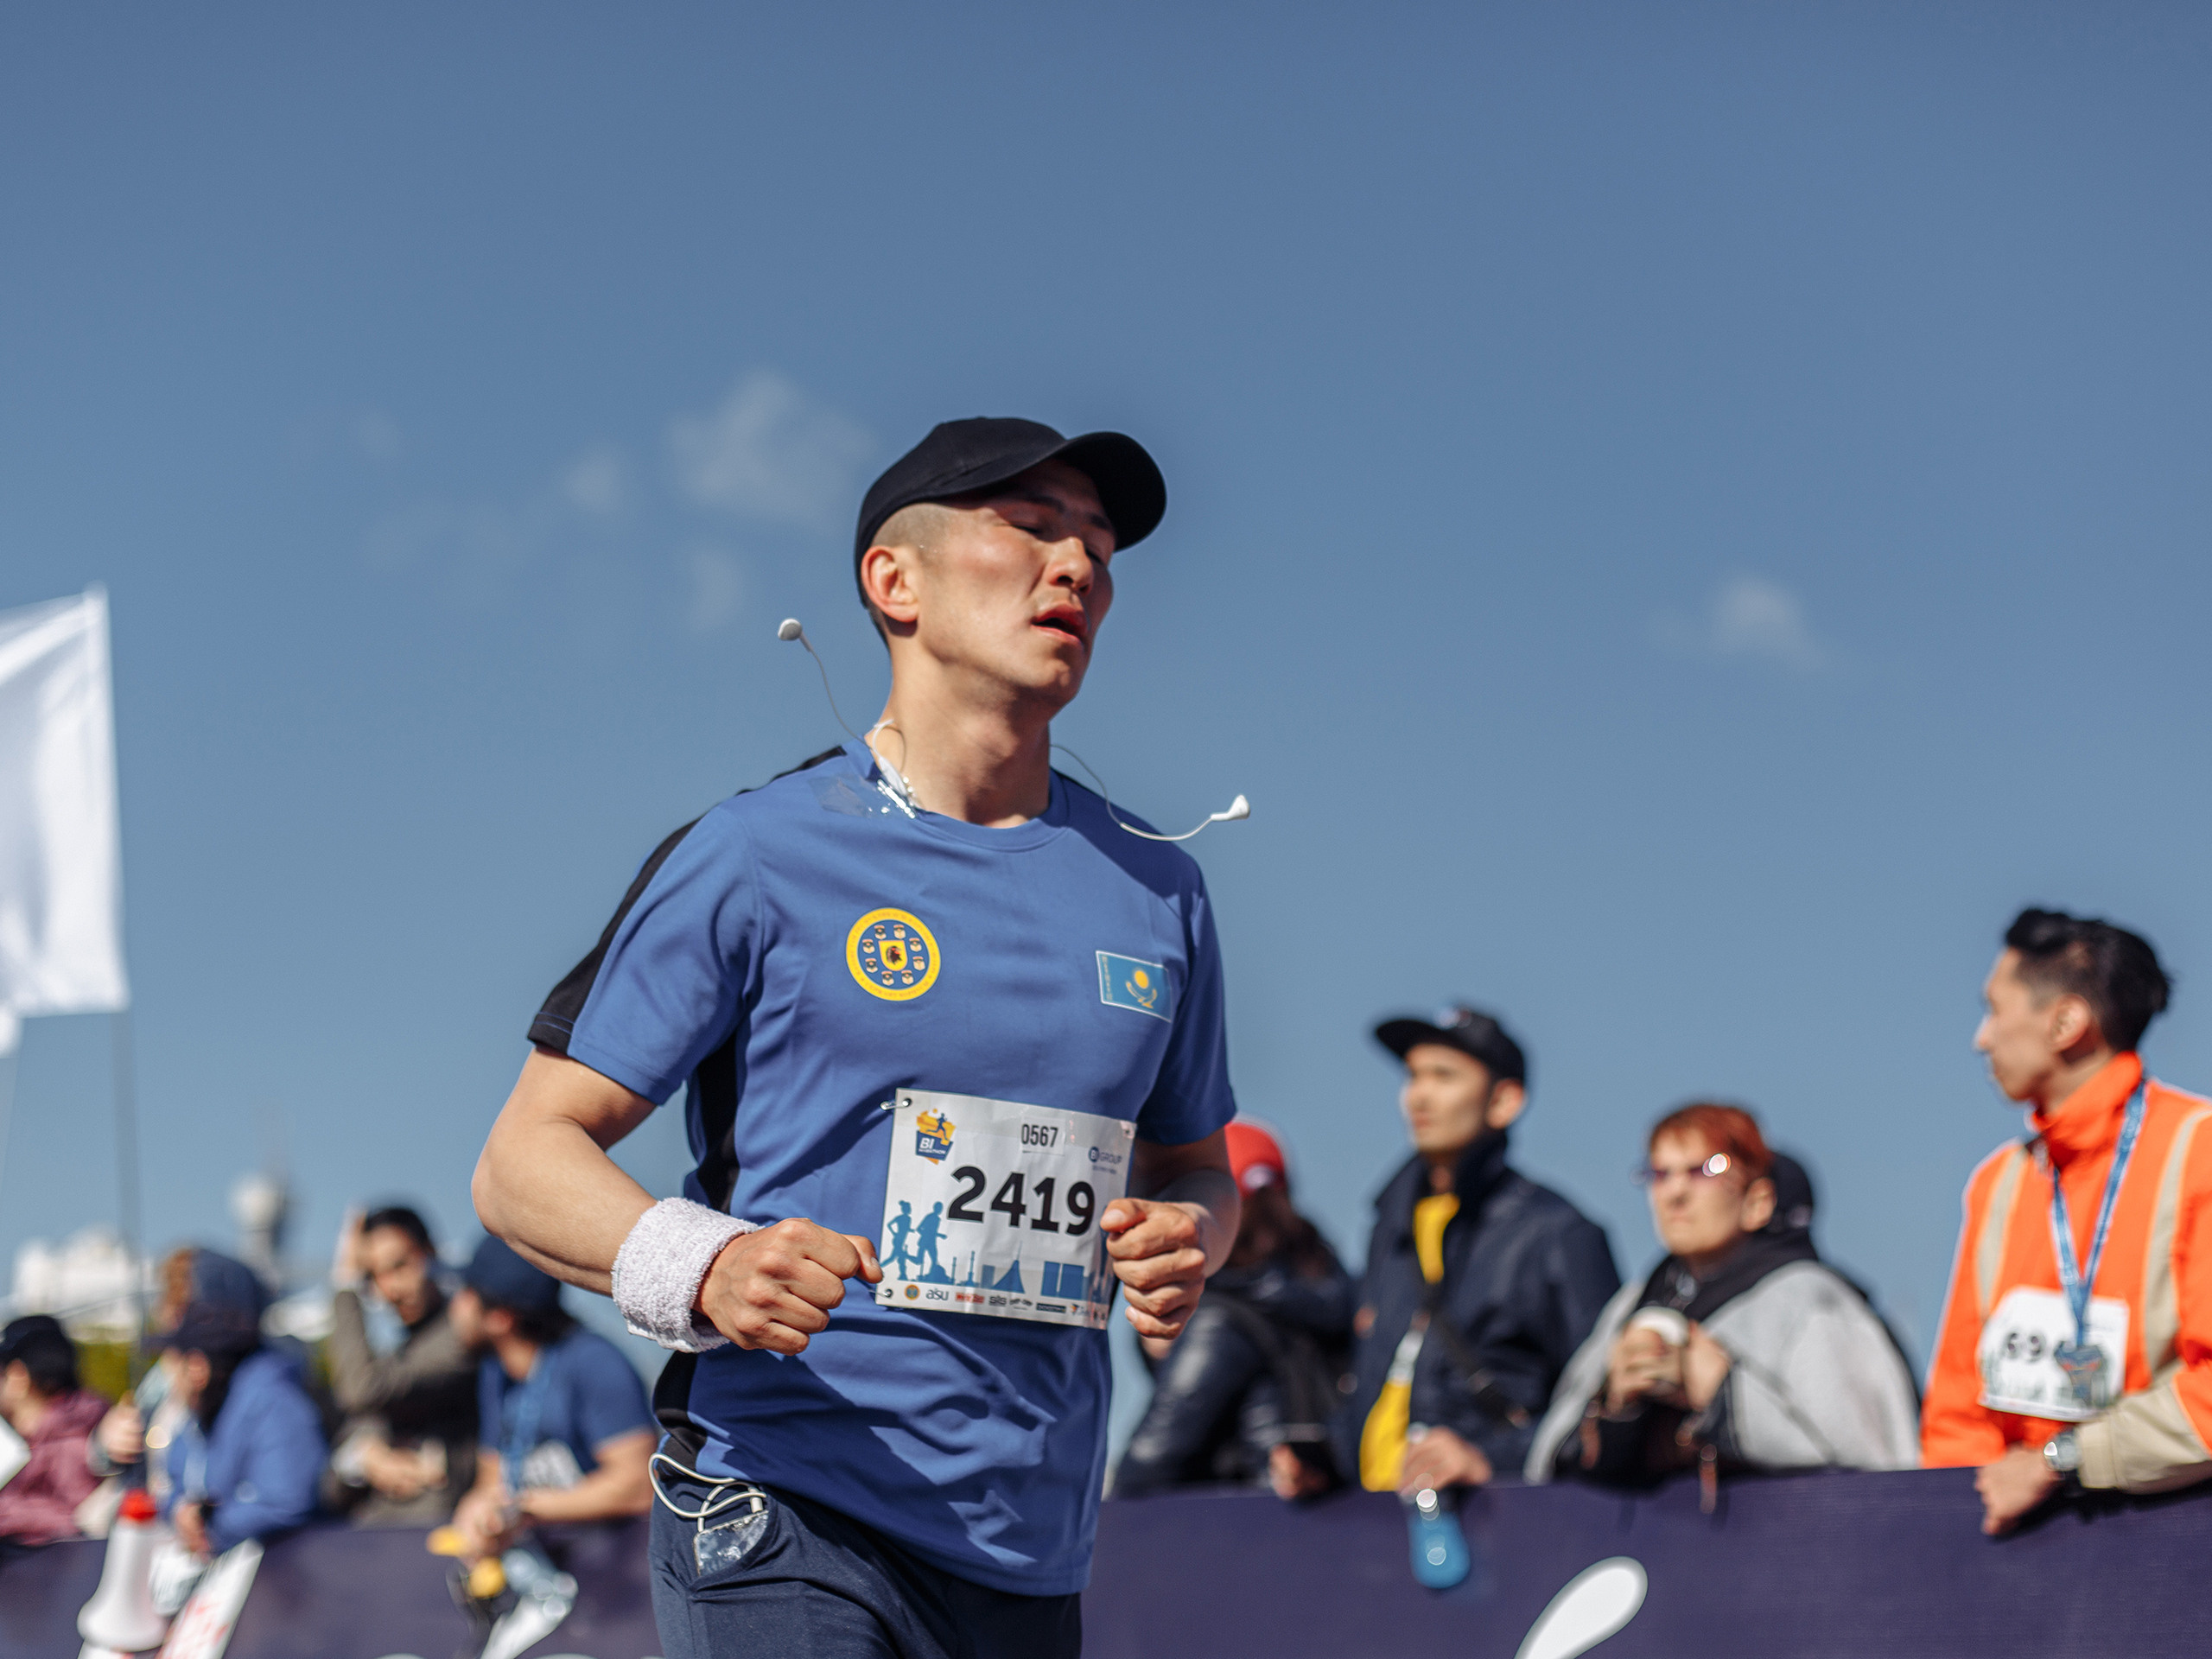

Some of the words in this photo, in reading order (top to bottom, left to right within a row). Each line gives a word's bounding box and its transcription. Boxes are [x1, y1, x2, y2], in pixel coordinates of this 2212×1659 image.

[919, 1137, 935, 1149] BI
[1021, 1123, 1058, 1147] 0567
[948, 1166, 1095, 1236] 2419
